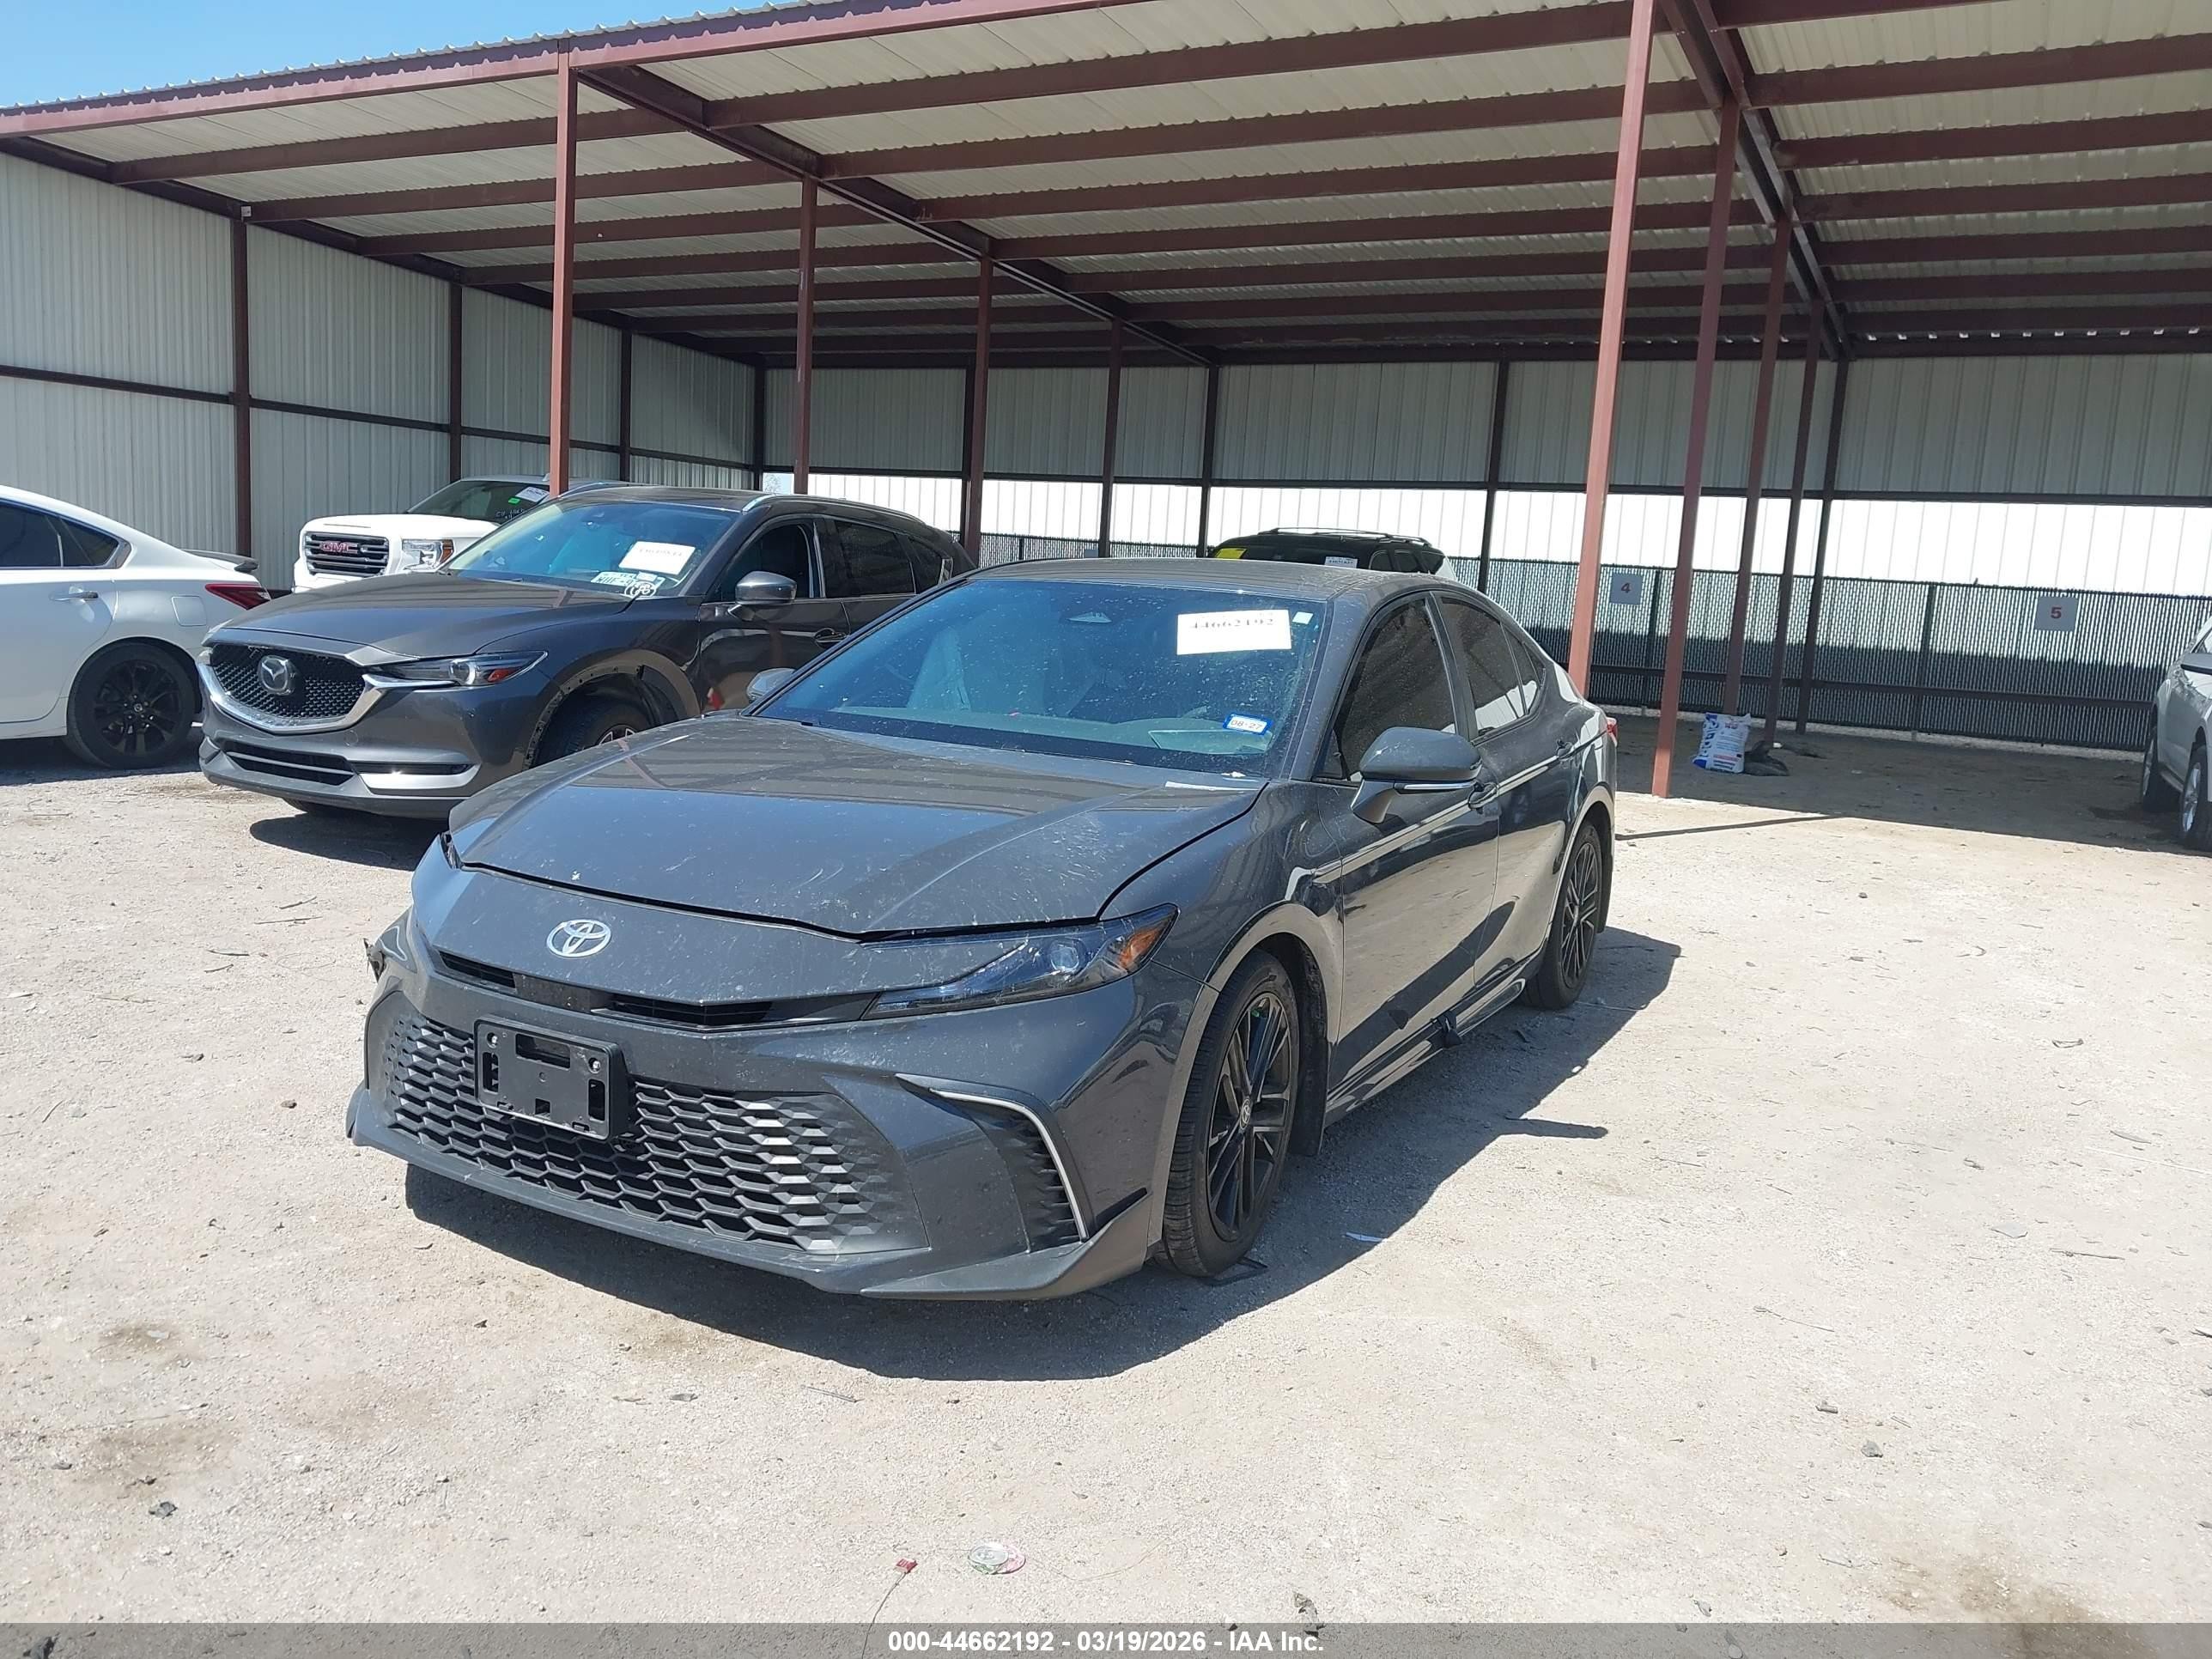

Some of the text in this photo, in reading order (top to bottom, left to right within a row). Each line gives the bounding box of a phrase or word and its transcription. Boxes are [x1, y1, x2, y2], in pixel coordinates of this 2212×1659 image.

[320, 540, 359, 555] GMC
[1620, 582, 1632, 593] 4
[2050, 606, 2063, 619] 5
